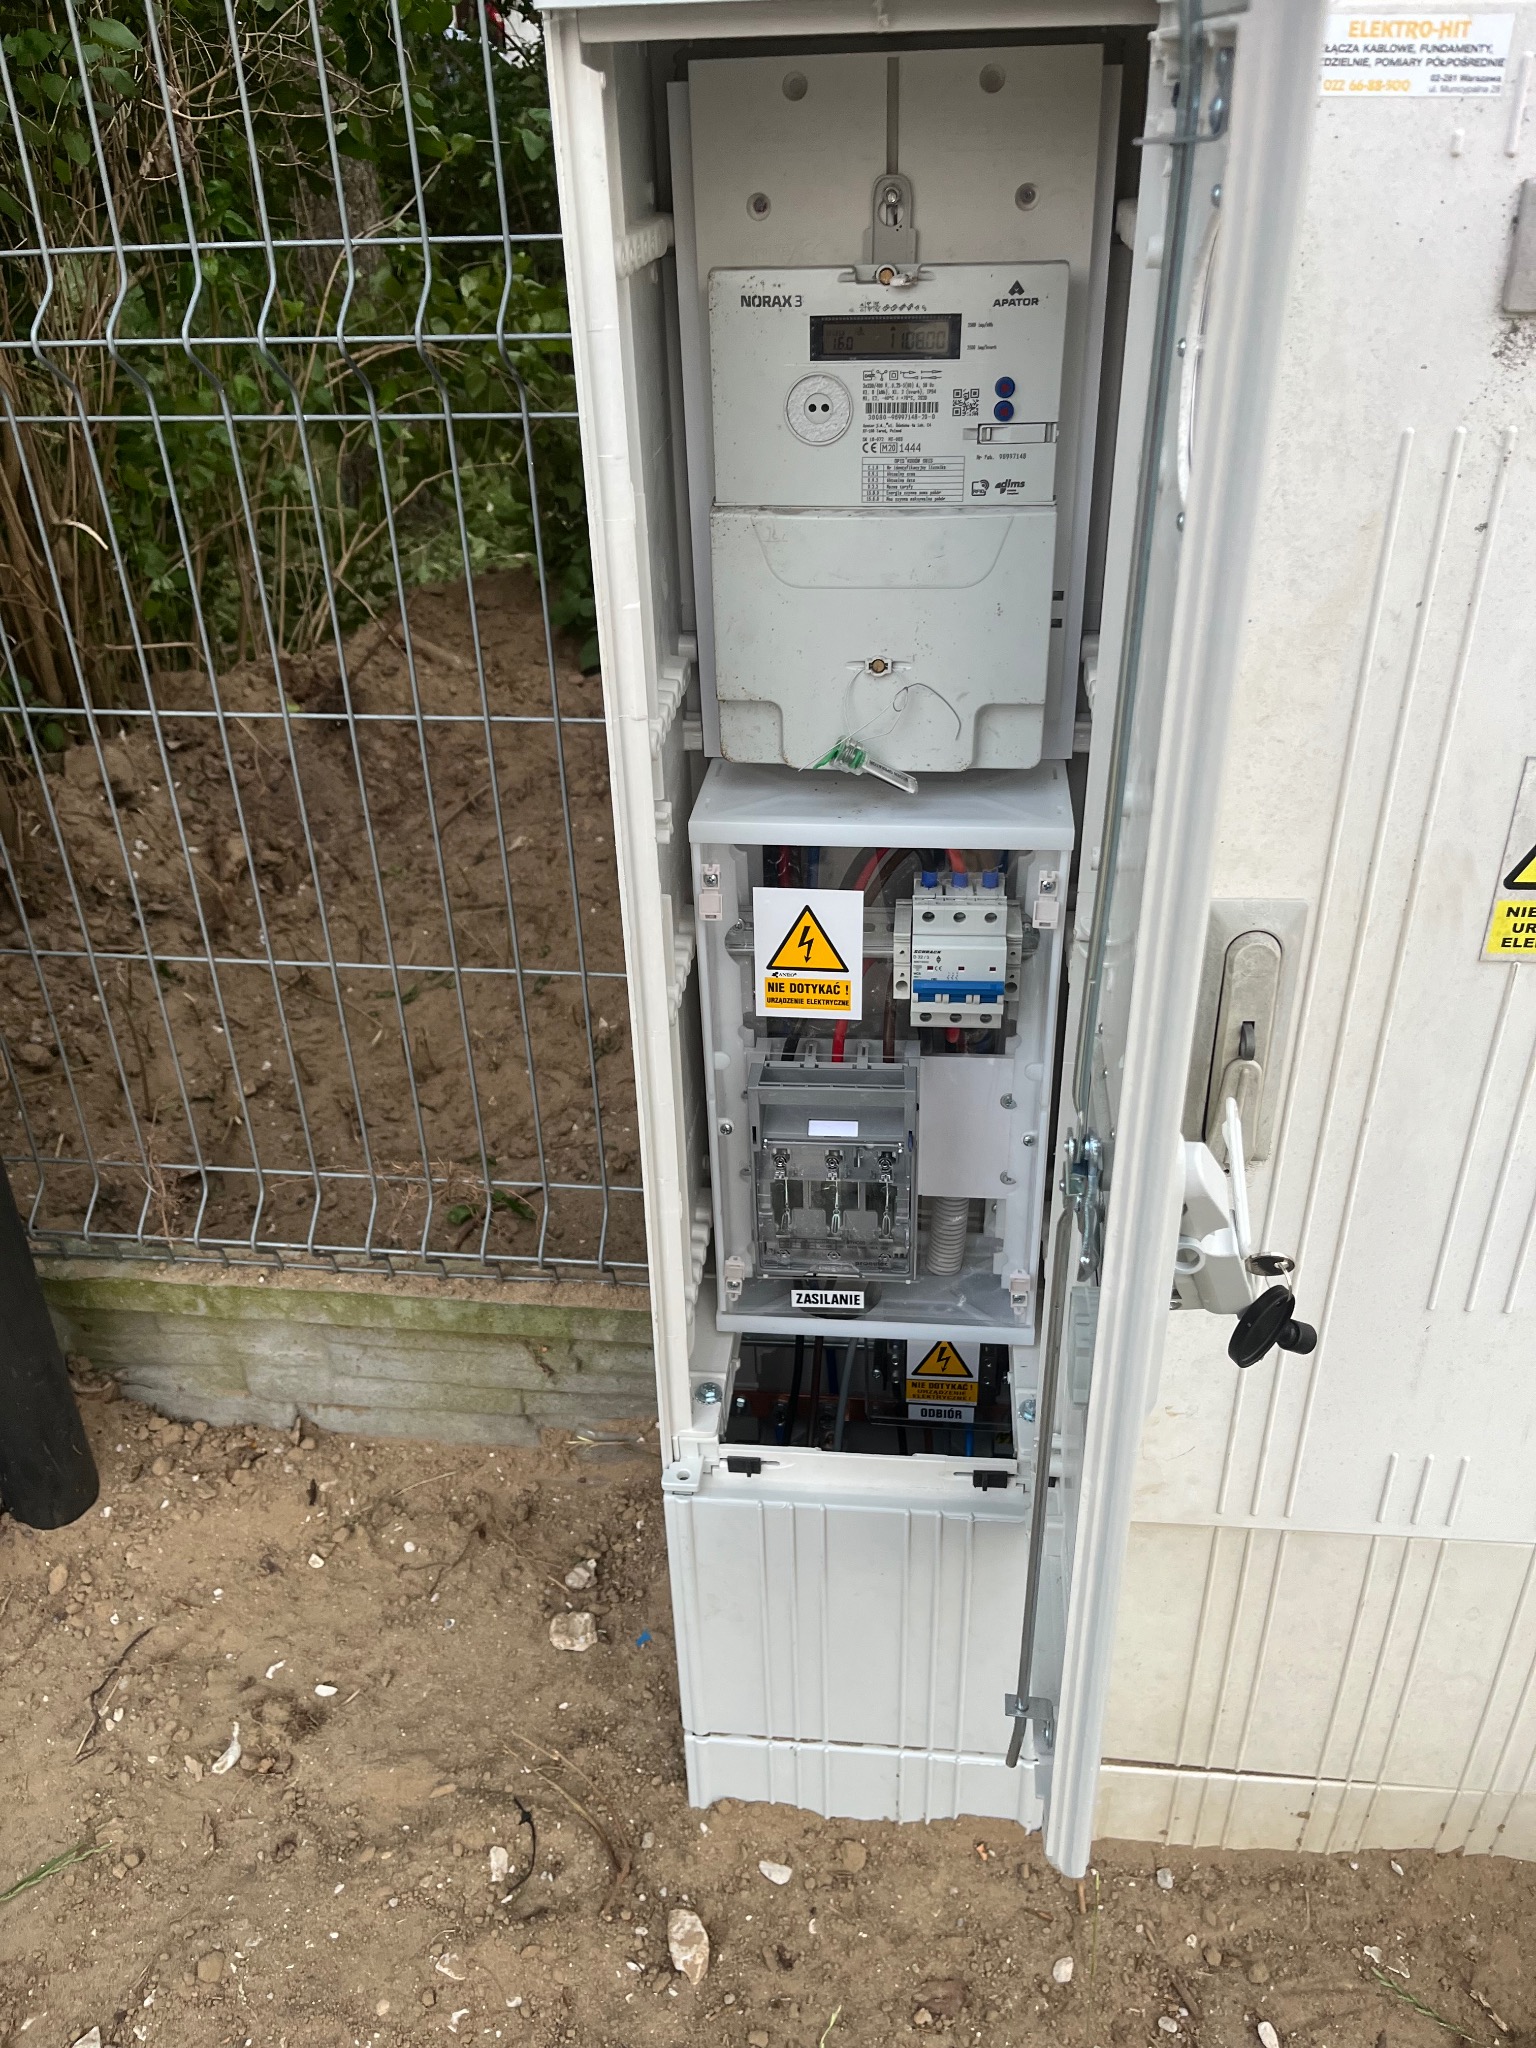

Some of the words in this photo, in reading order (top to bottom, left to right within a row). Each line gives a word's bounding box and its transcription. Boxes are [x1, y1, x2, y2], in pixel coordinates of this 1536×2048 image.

[1348, 20, 1473, 39] ELEKTRO-HIT
[1320, 57, 1371, 68] DZIELNIE,
[1375, 57, 1423, 67] POMIARY
[1323, 79, 1345, 91] 022
[741, 295, 792, 308] NORAX
[795, 295, 803, 308] 3
[993, 297, 1039, 308] APATOR
[881, 444, 896, 452] M20
[899, 443, 921, 453] 1444
[1001, 479, 1025, 488] dlms
[1506, 907, 1536, 918] NIE
[1501, 938, 1536, 948] ELE
[768, 982, 785, 993] NIE
[790, 982, 841, 995] DOTYKAĆ
[845, 985, 849, 995] !
[767, 997, 804, 1005] URZĄDZENIE
[806, 998, 850, 1006] ELEKTRYCZNE
[796, 1293, 861, 1306] ZASILANIE
[912, 1381, 926, 1389] NIE
[929, 1382, 968, 1391] DOTYKAĆ
[921, 1407, 962, 1420] ODBIÓR
